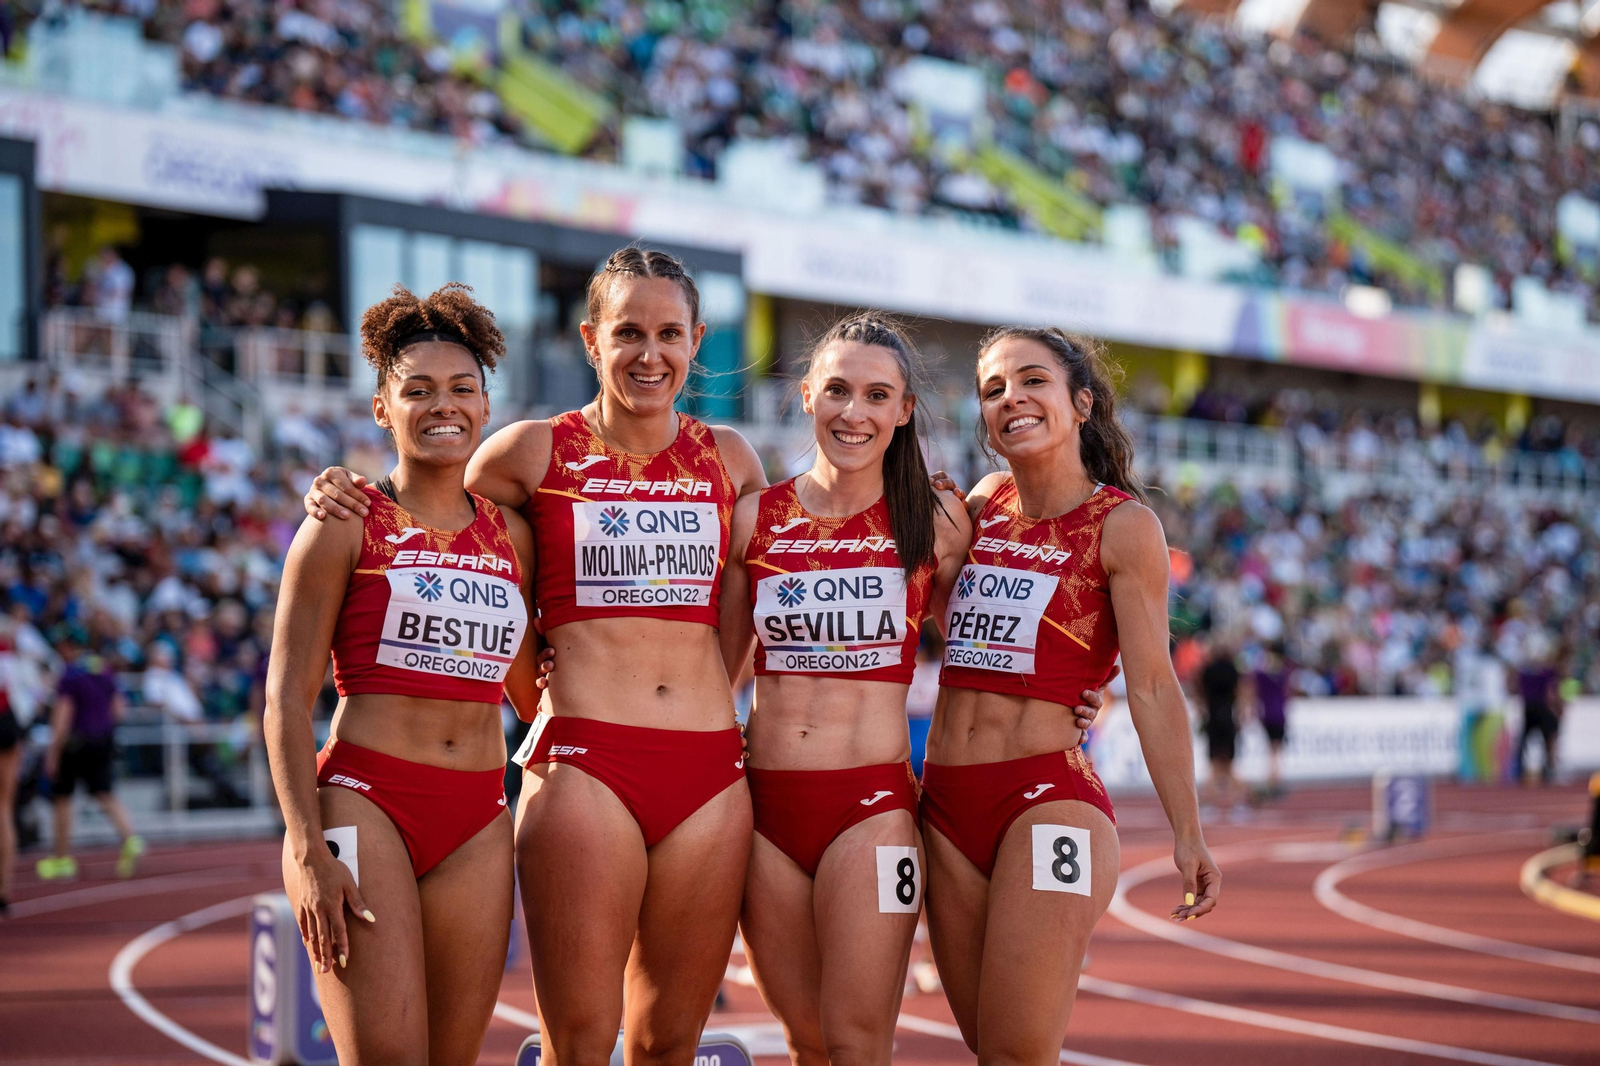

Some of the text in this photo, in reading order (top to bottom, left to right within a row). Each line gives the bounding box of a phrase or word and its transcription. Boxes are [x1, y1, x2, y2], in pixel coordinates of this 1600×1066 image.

[580, 478, 712, 497] ESPAÑA
[636, 509, 701, 534] QNB
[392, 550, 512, 575] ESPAÑA
[582, 544, 715, 577] MOLINA-PRADOS
[974, 536, 1071, 565] ESPAÑA
[450, 578, 509, 608] QNB
[603, 588, 699, 604] OREGON22
[813, 576, 884, 602] QNB
[979, 574, 1034, 600] QNB
[398, 612, 516, 655] BESTUÉ
[764, 609, 897, 642] SEVILLA
[948, 606, 1021, 643] PÉREZ
[405, 652, 500, 680] OREGON22
[786, 651, 880, 669] OREGON22
[548, 746, 588, 758] ESP
[328, 773, 372, 792] ESP
[1052, 836, 1081, 884] 8
[896, 857, 916, 905] 8
